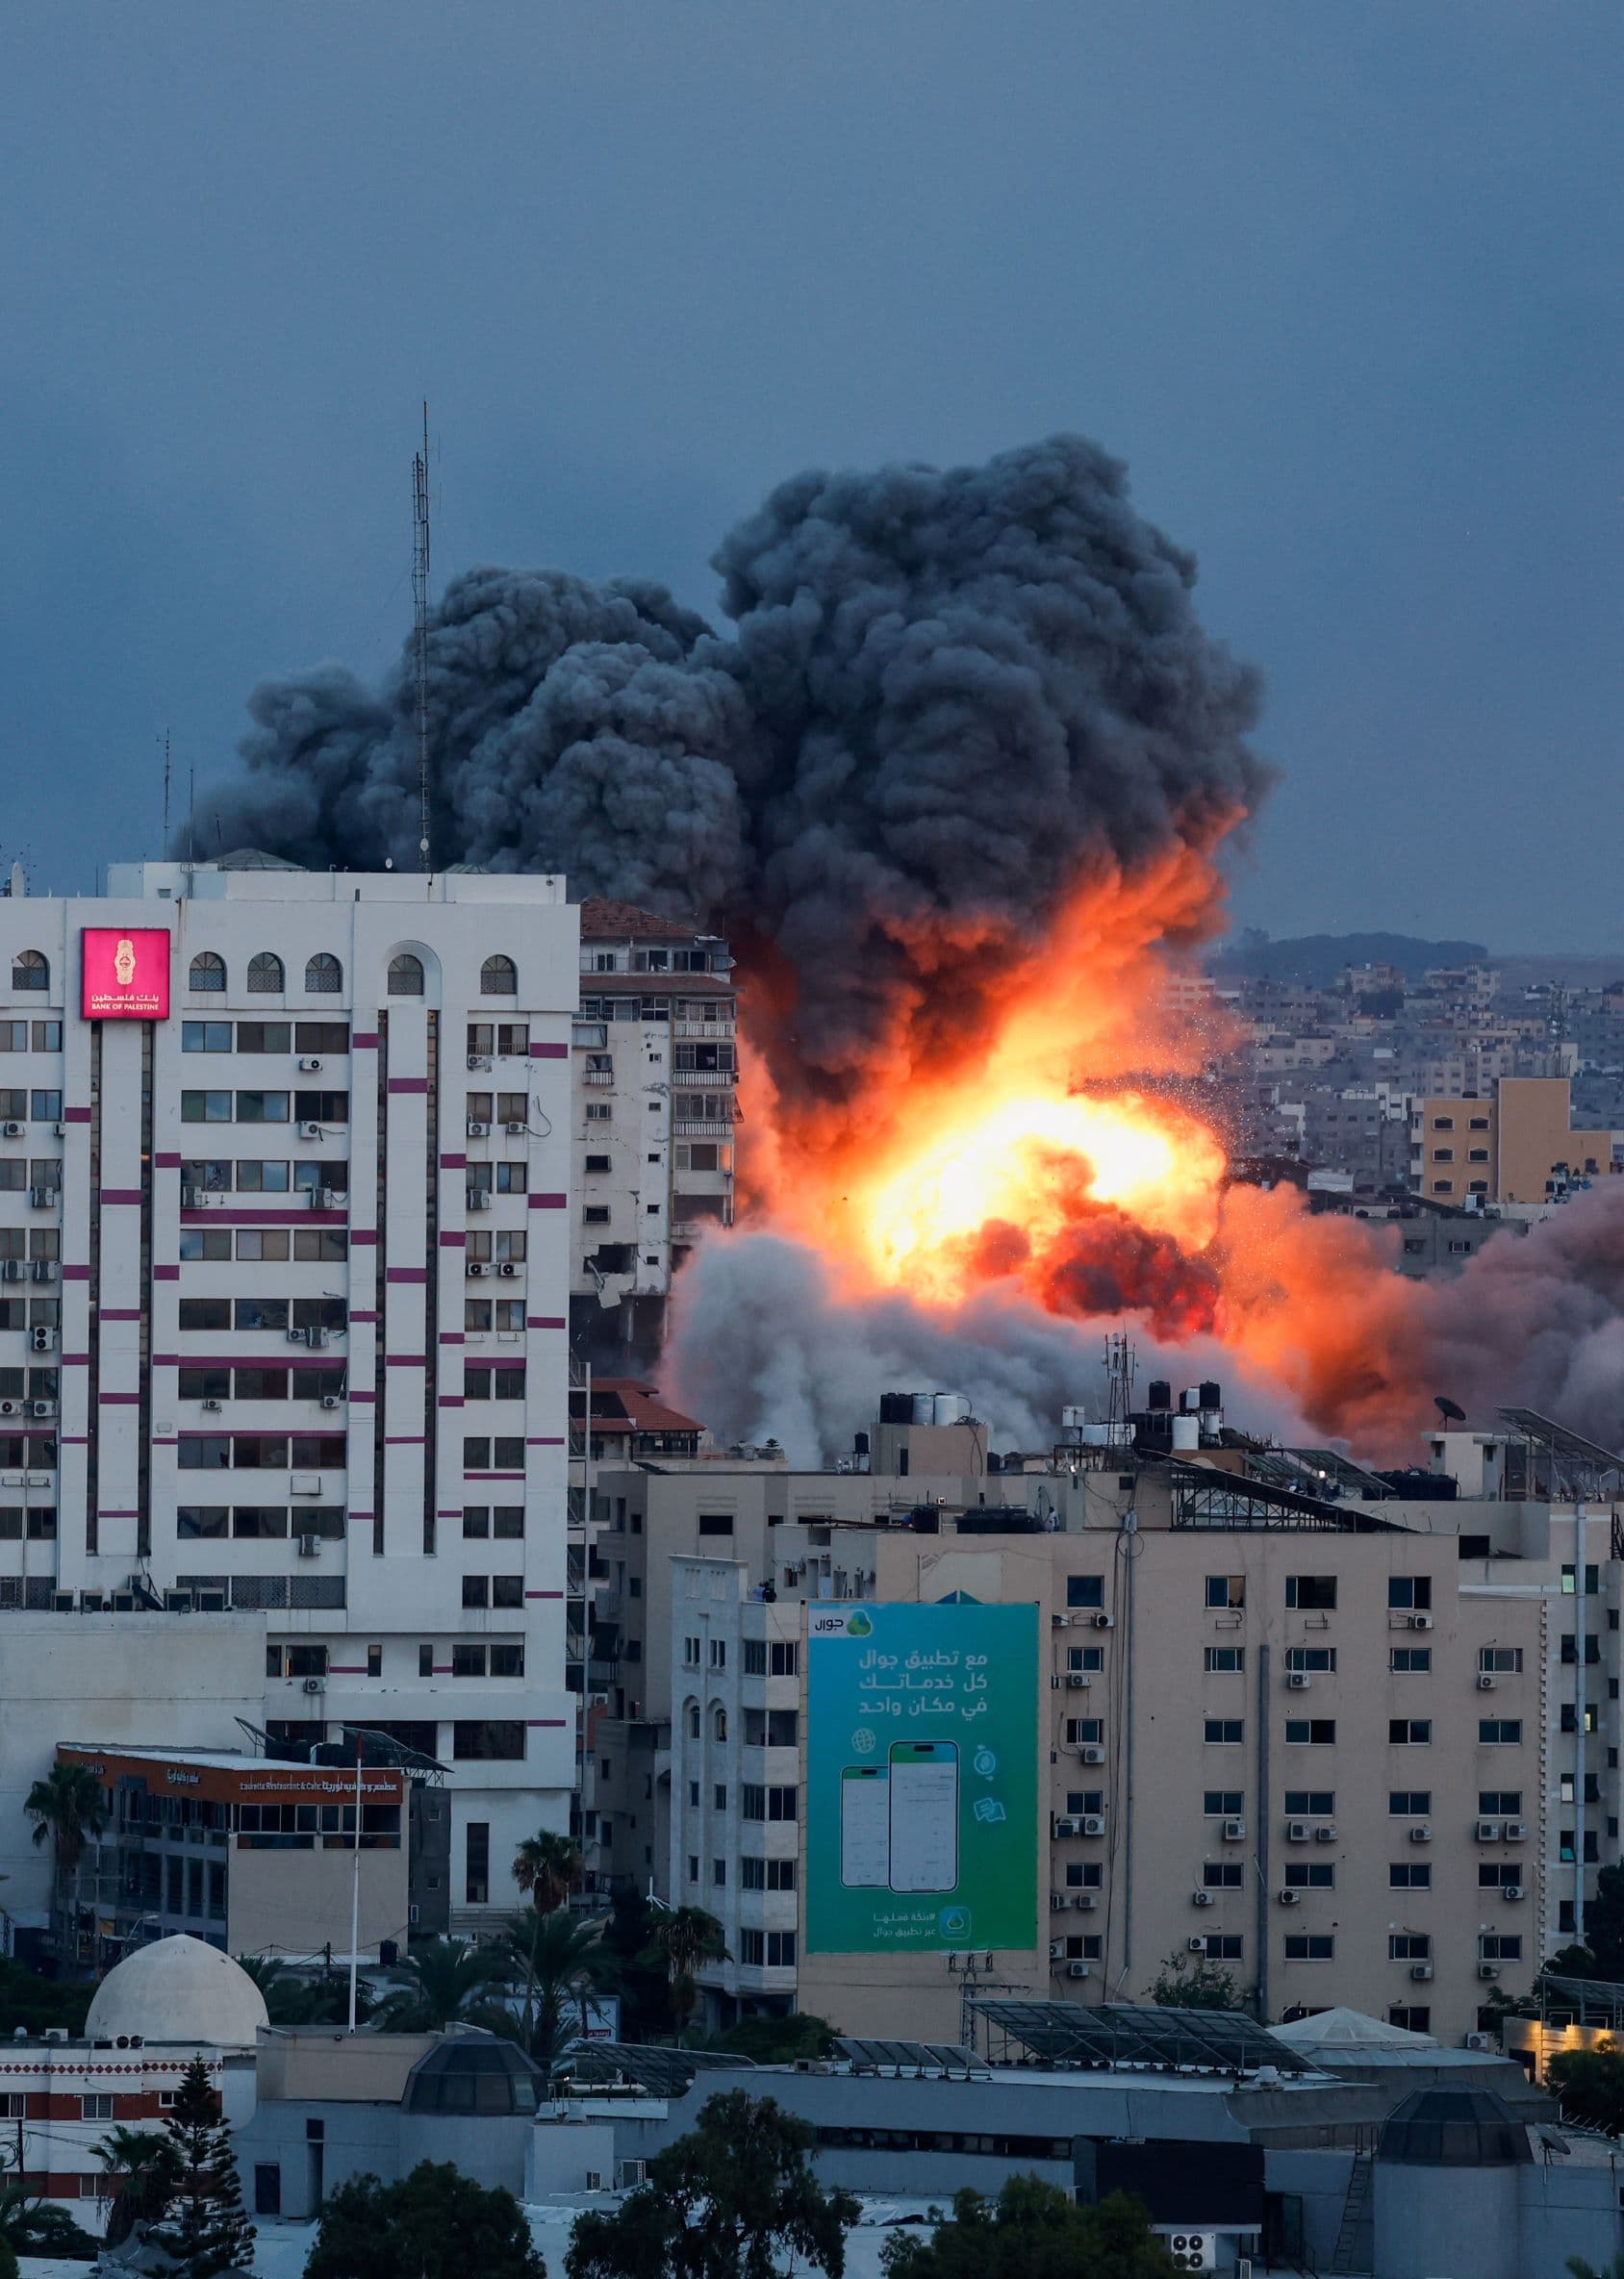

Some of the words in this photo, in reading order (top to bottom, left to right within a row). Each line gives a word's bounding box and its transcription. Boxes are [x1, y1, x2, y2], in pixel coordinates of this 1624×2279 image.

[91, 994, 134, 1002] فلسطين
[137, 994, 159, 1002] بنك
[815, 1617, 844, 1631] جوال
[858, 1650, 899, 1670] جوال
[904, 1649, 959, 1670] تطبيق
[965, 1655, 988, 1670] مع
[859, 1673, 954, 1689] خدماتك
[963, 1673, 988, 1692] كل
[858, 1697, 901, 1716] واحد
[908, 1697, 955, 1716] مكان
[961, 1697, 988, 1721] في
[266, 1782, 300, 1790] Restaurant
